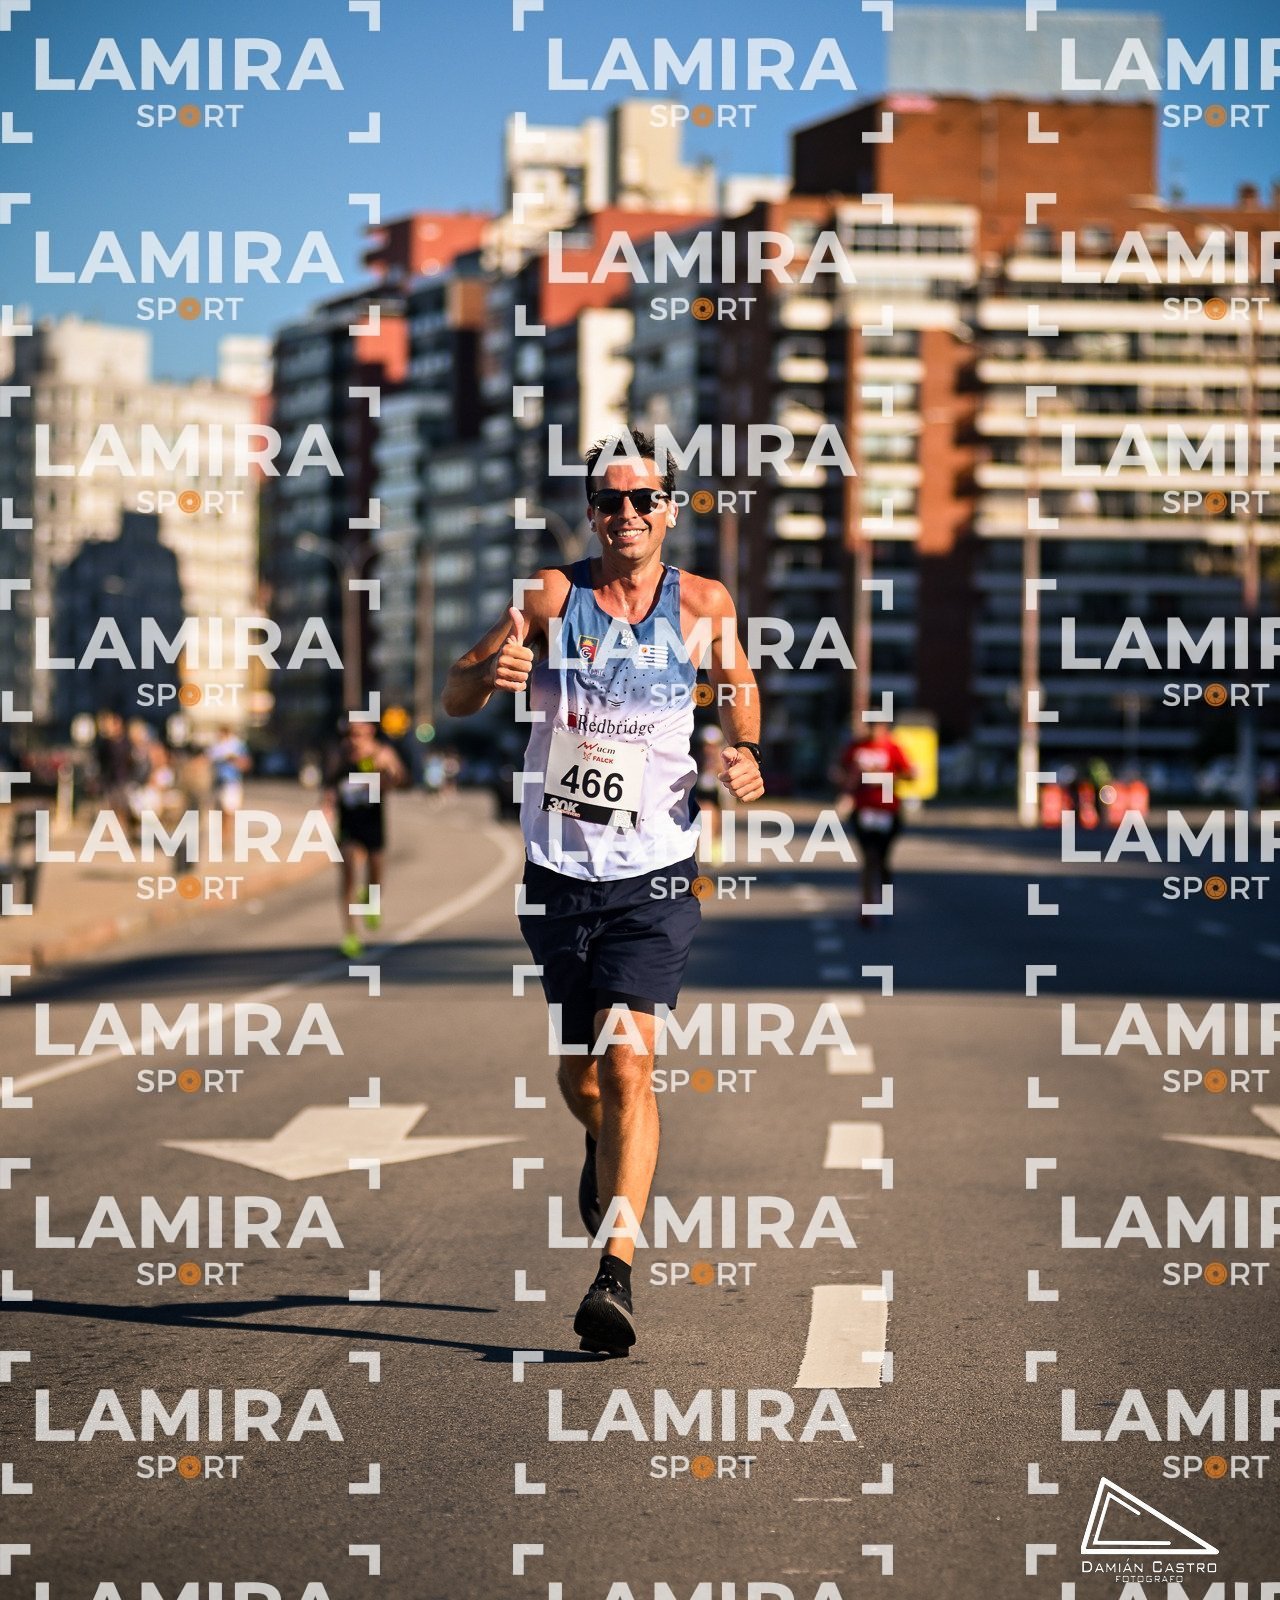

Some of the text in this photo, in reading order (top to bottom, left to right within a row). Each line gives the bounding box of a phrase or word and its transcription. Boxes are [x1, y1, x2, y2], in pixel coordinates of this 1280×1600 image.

[579, 713, 655, 737] Redbridge
[592, 755, 614, 765] FALCK
[560, 764, 624, 803] 466
[547, 797, 580, 814] 30K
